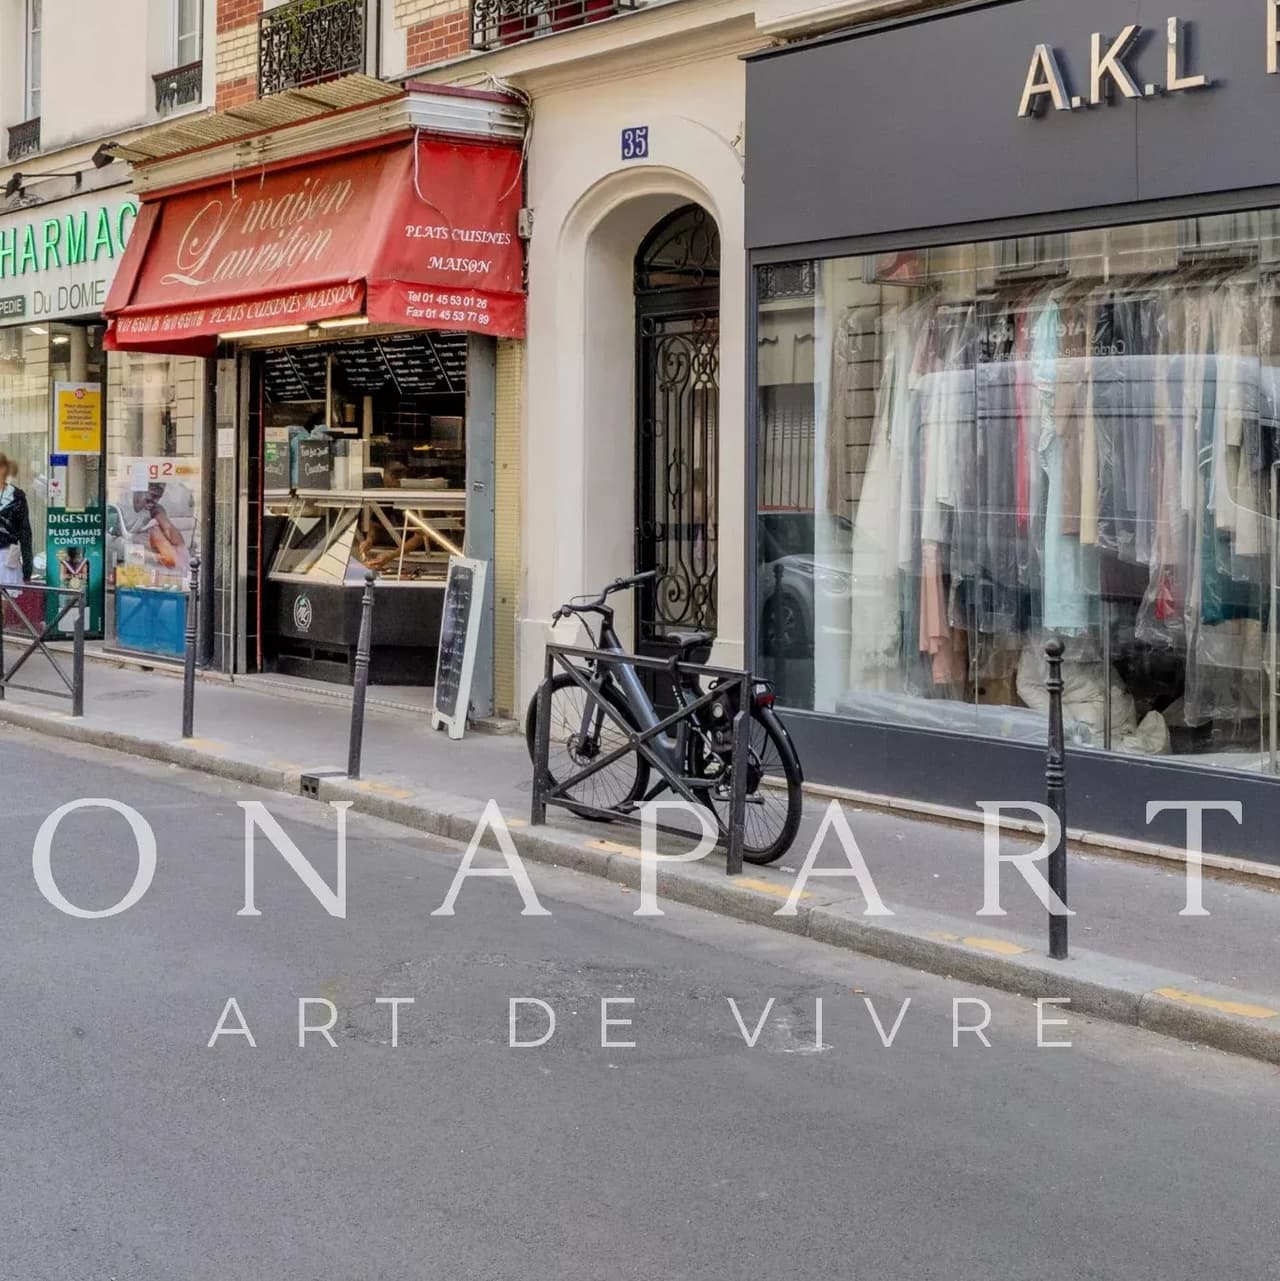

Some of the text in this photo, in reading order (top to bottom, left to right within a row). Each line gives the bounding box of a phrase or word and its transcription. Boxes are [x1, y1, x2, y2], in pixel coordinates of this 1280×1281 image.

[624, 128, 646, 157] 35
[405, 225, 449, 240] PLATS
[427, 256, 492, 273] MAISON
[58, 280, 106, 311] DOME
[209, 304, 245, 323] PLATS
[303, 284, 360, 310] MAISON
[408, 291, 488, 309] Tel 01 45 53 01 26
[406, 306, 425, 317] Fax
[425, 307, 436, 318] 01
[48, 514, 102, 523] DIGESTIC
[48, 528, 101, 537] PLUS JAMAIS
[54, 535, 96, 545] CONSTIPÉ
